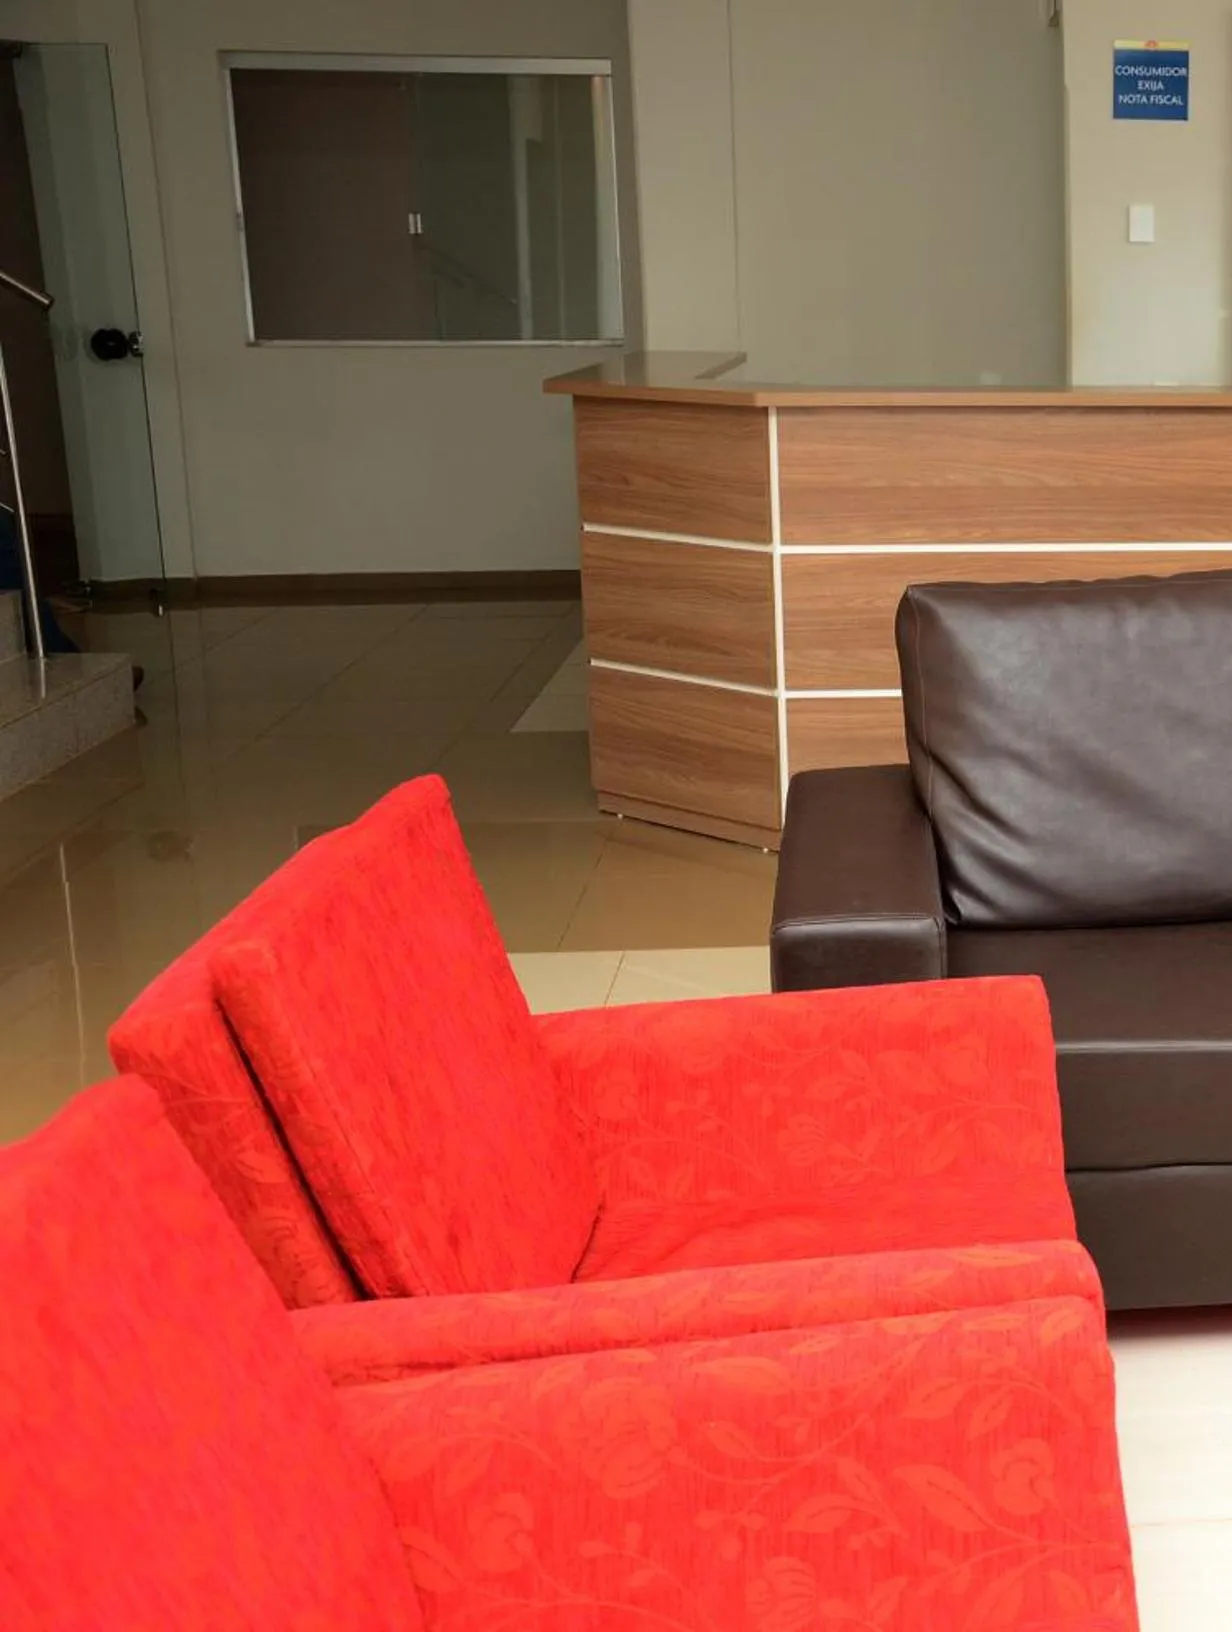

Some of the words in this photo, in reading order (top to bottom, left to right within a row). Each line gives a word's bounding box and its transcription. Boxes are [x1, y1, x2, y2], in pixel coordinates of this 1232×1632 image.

[1115, 65, 1187, 77] CONSUMIDOR
[1137, 80, 1164, 91] EXIJA
[1119, 94, 1147, 104] NOTA
[1150, 95, 1184, 105] FISCAL
